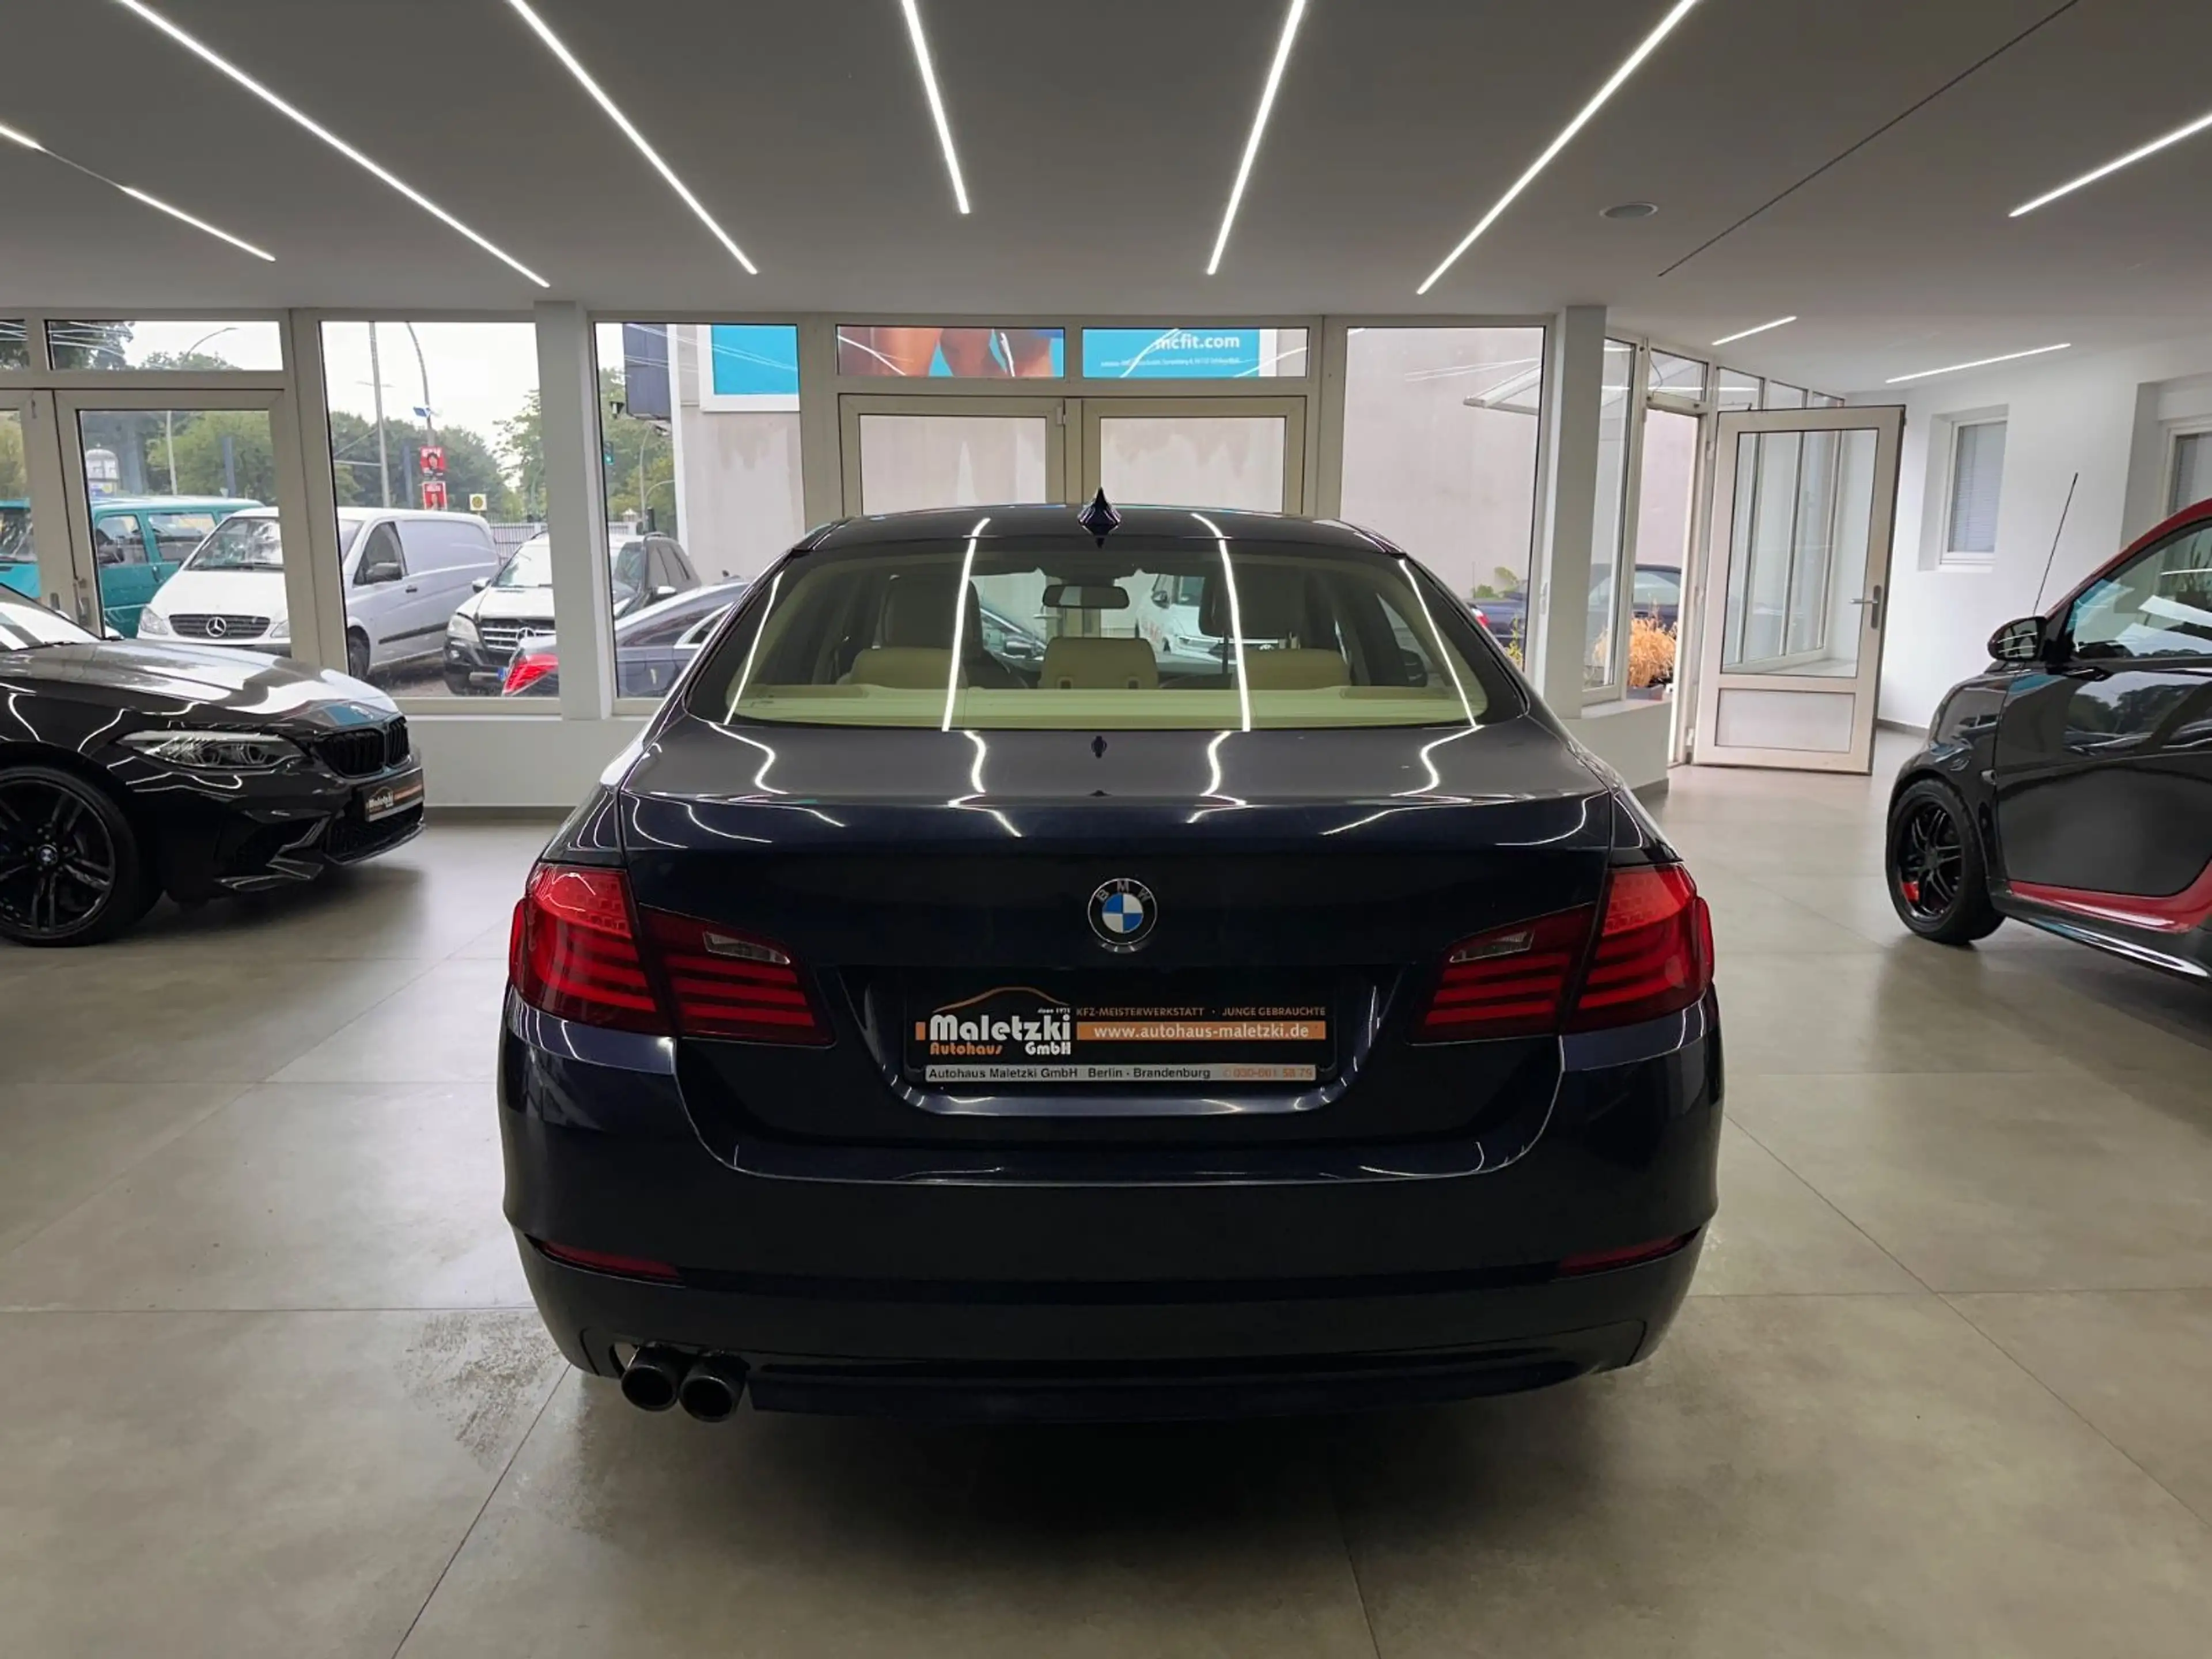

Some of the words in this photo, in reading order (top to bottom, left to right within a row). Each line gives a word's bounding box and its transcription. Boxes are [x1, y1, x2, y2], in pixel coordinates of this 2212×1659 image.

[1095, 879, 1152, 902] BMW
[1076, 1007, 1204, 1017] KFZ-MEISTERWERKSTATT
[1222, 1007, 1256, 1016] JUNGE
[1258, 1007, 1326, 1016] GEBRAUCHTE
[930, 1014, 1070, 1041] Maletzki
[1094, 1022, 1309, 1038] www.autohaus-maletzki.de
[930, 1041, 1002, 1055] Autohaus
[1025, 1041, 1071, 1055] GmbH
[929, 1068, 986, 1078] Autohaus
[989, 1068, 1037, 1078] Maletzki
[1040, 1068, 1078, 1078] GmbH
[1088, 1067, 1123, 1078] Berlin
[1133, 1067, 1211, 1079] Brandenburg
